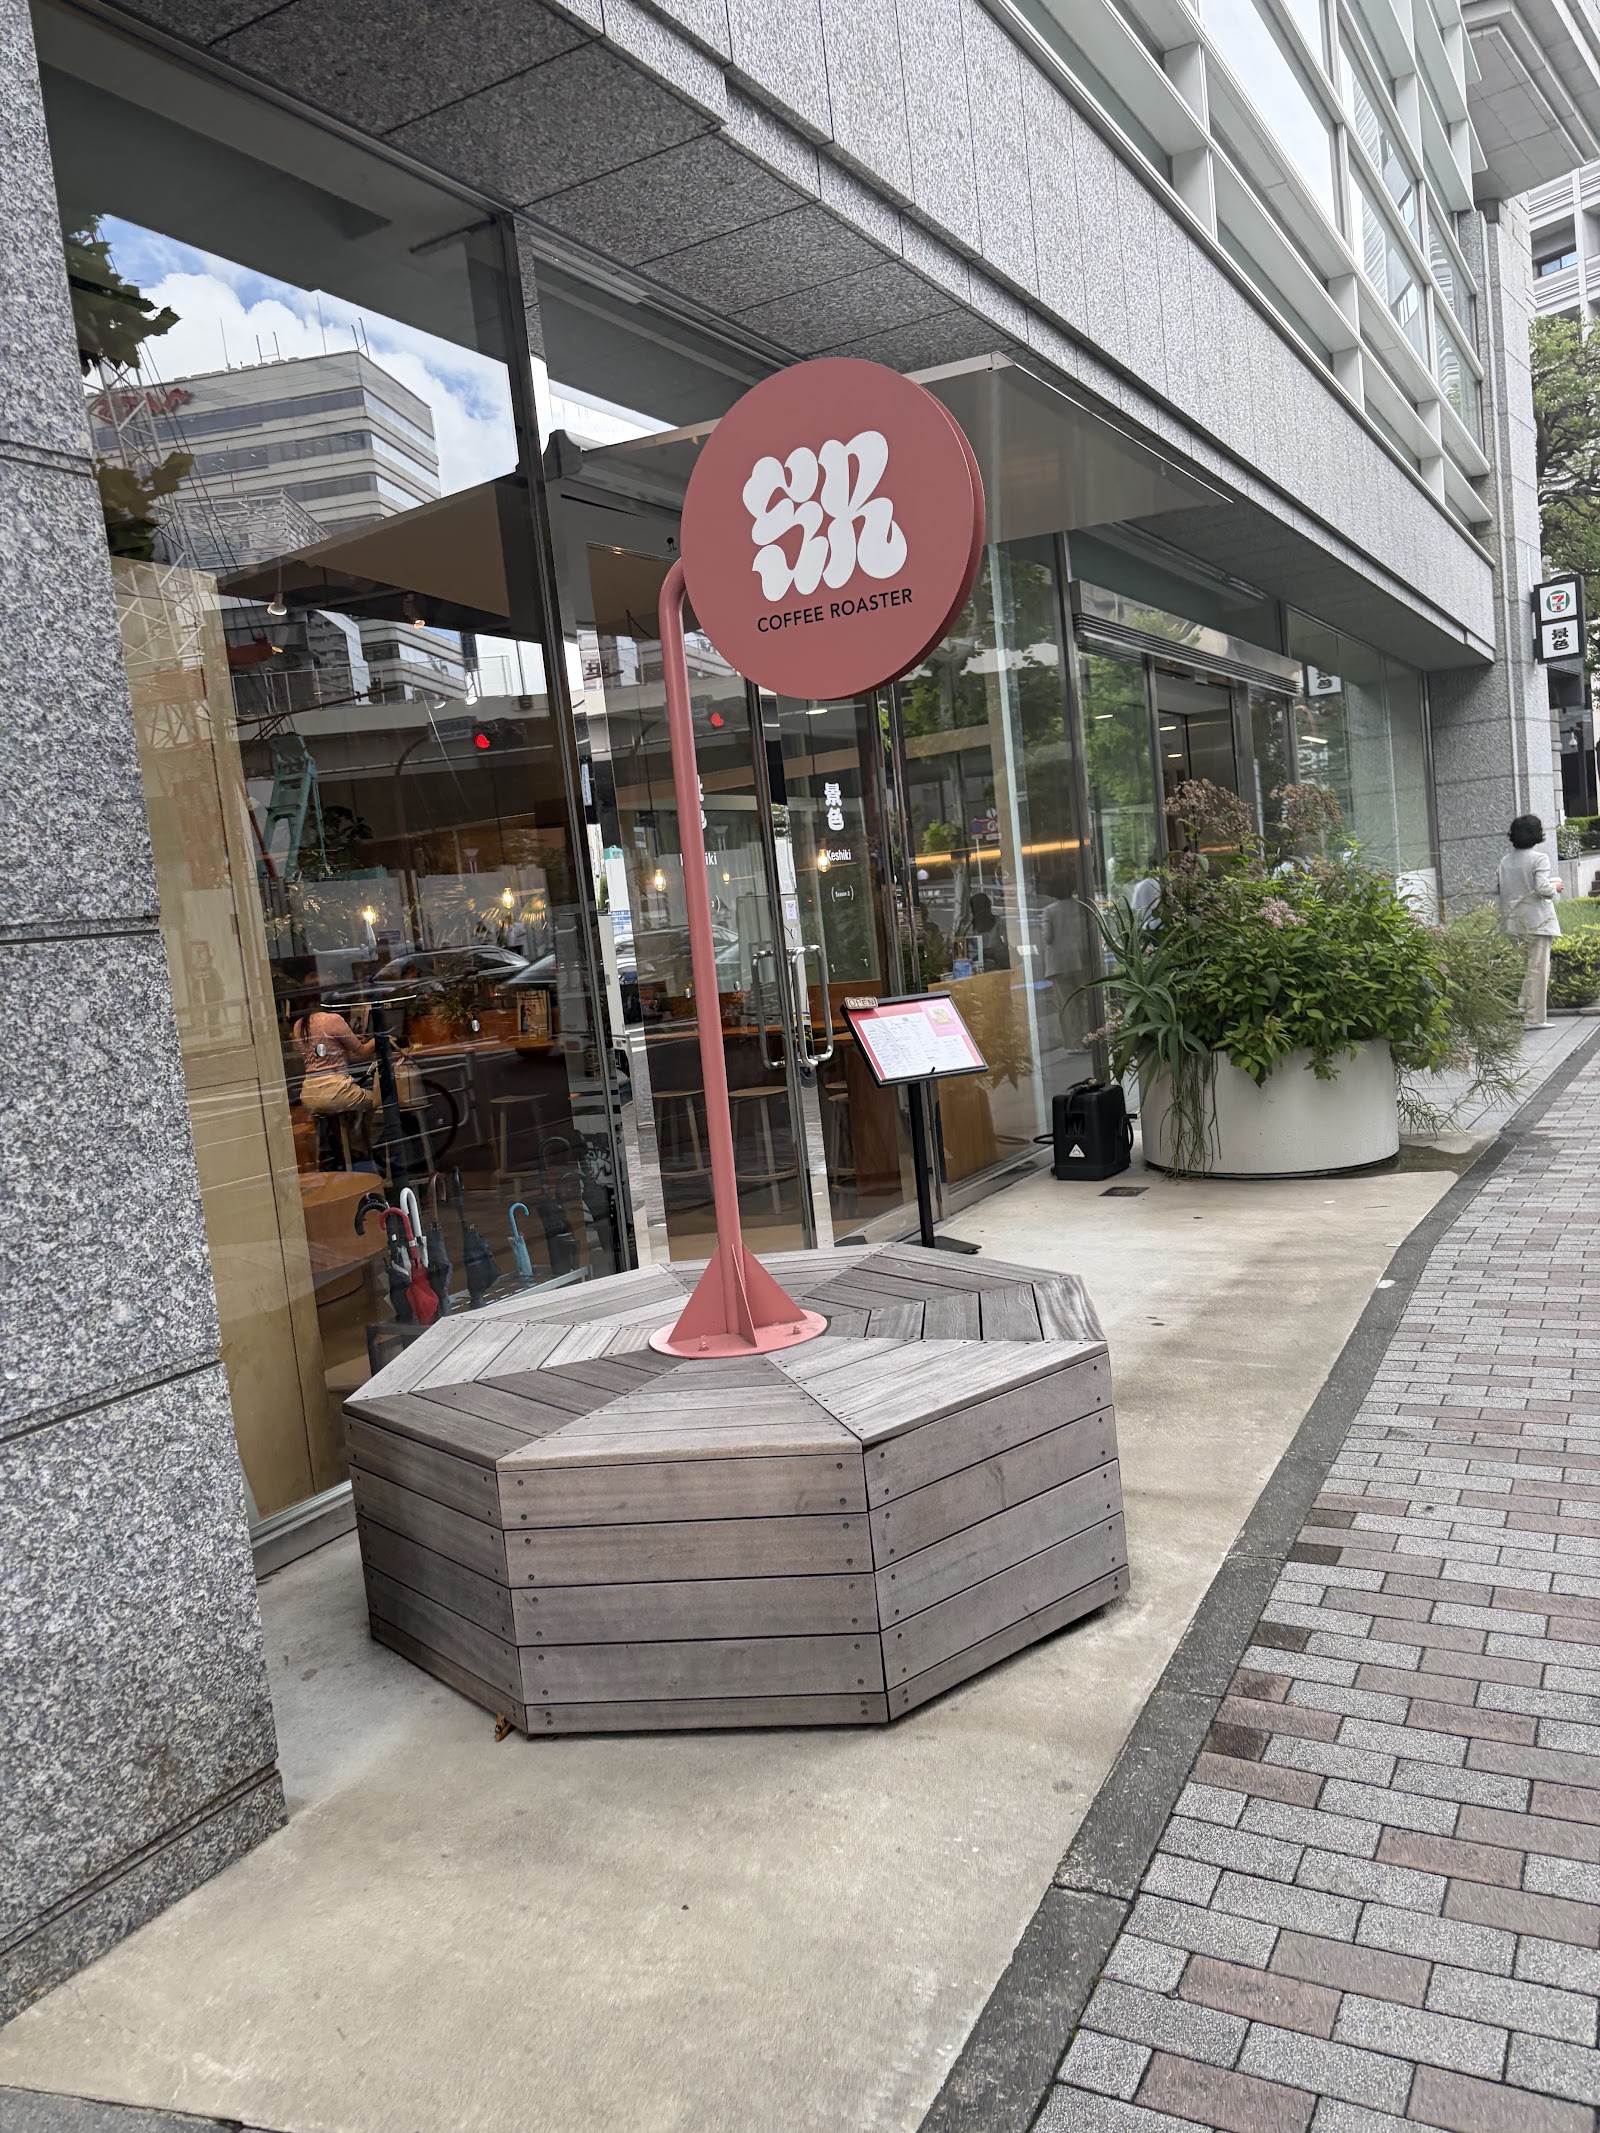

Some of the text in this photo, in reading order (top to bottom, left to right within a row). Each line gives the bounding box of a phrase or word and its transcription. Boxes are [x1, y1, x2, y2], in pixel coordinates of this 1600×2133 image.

[757, 588, 913, 633] COFFEE ROASTER
[824, 782, 844, 830] 景色
[826, 849, 852, 861] Keshiki
[848, 999, 875, 1007] OPEN
